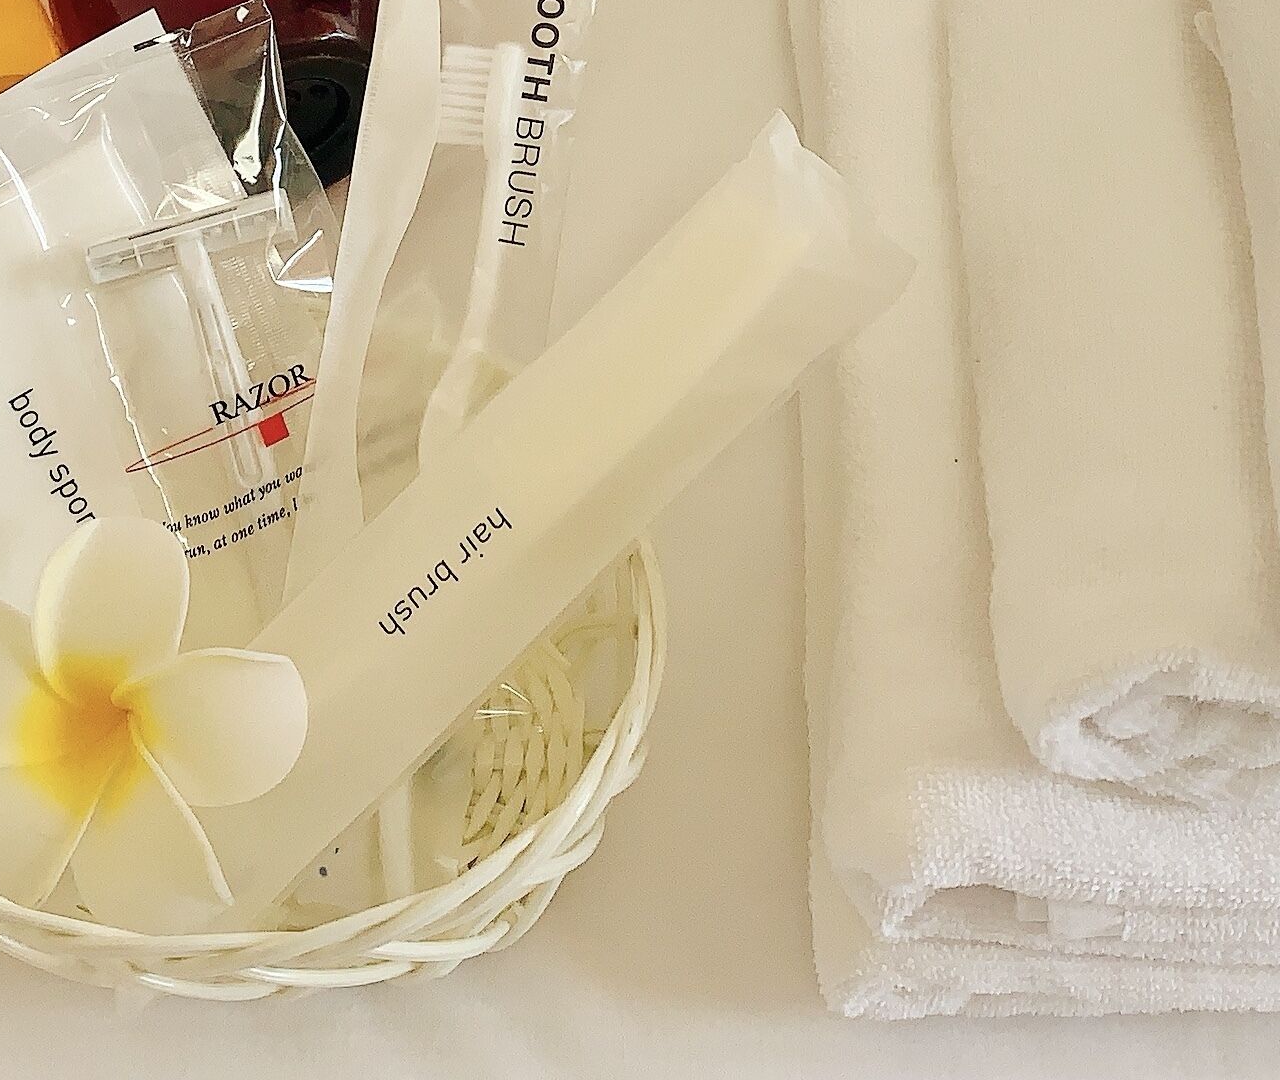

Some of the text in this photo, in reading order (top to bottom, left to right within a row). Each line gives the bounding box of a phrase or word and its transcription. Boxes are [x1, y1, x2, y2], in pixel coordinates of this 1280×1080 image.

[498, 116, 545, 246] BRUSH
[8, 388, 58, 459] body
[209, 364, 313, 425] RAZOR
[184, 508, 220, 528] know
[223, 489, 256, 514] what
[258, 478, 281, 500] you
[213, 534, 227, 550] at
[231, 524, 254, 543] one
[257, 506, 291, 529] time,
[378, 507, 512, 636] hair brush
